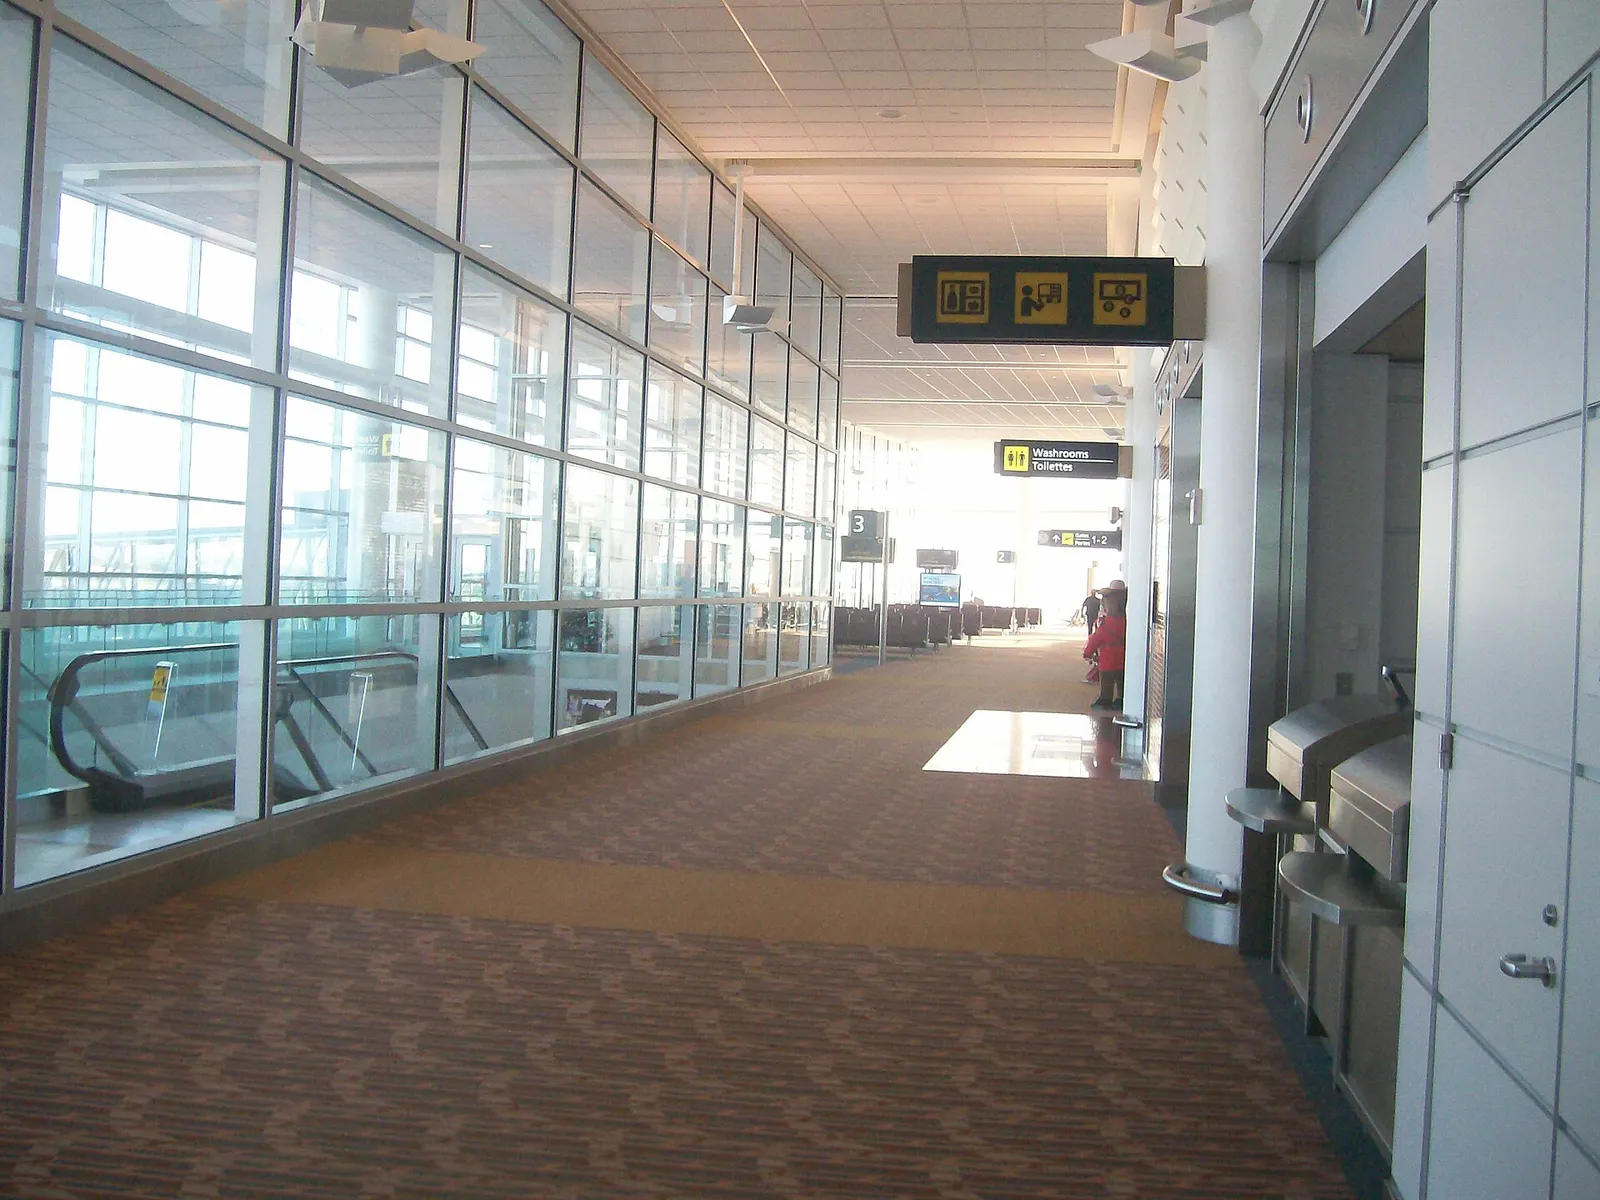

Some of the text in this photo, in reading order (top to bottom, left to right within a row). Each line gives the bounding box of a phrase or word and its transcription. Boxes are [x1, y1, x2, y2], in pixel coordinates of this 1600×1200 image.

[1032, 448, 1089, 459] Washrooms
[1032, 461, 1073, 471] Toilettes
[852, 515, 865, 533] 3
[998, 551, 1005, 562] 2
